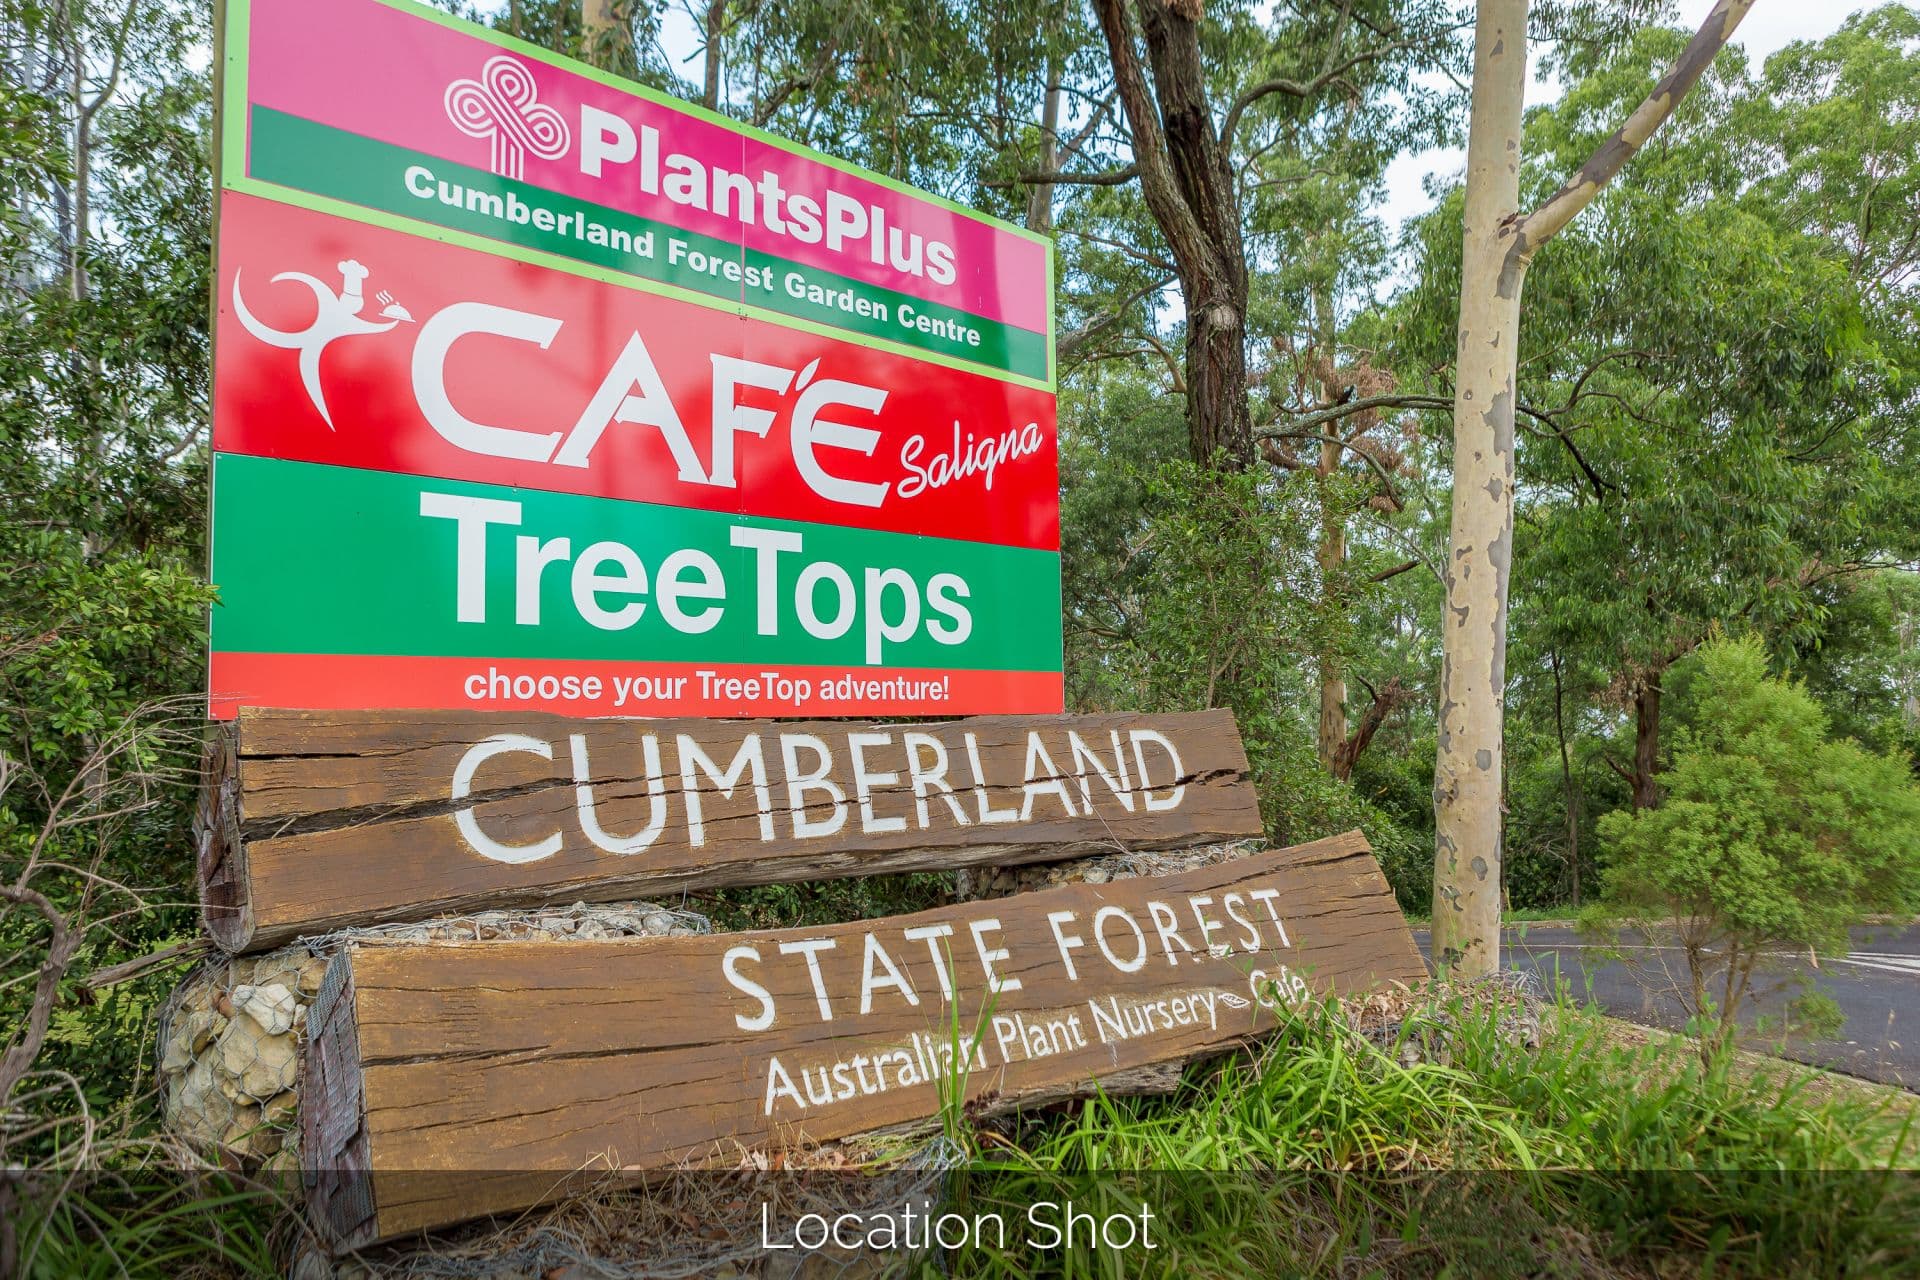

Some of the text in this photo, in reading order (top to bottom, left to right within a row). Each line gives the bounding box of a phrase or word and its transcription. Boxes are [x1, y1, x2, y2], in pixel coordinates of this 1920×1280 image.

[404, 165, 982, 347] Cumberland Forest Garden Centre
[580, 104, 957, 287] PlantsPlus
[412, 302, 890, 508] CAFÉ
[897, 420, 1043, 500] Saligna
[420, 491, 973, 666] TreeTops
[464, 667, 950, 708] choose your TreeTop adventure!
[451, 728, 1187, 866] CUMBERLAND
[722, 887, 1295, 1032] STATE FOREST
[763, 1032, 988, 1116] Australian
[992, 1012, 1088, 1065] Plant
[1088, 988, 1219, 1042] Nursery
